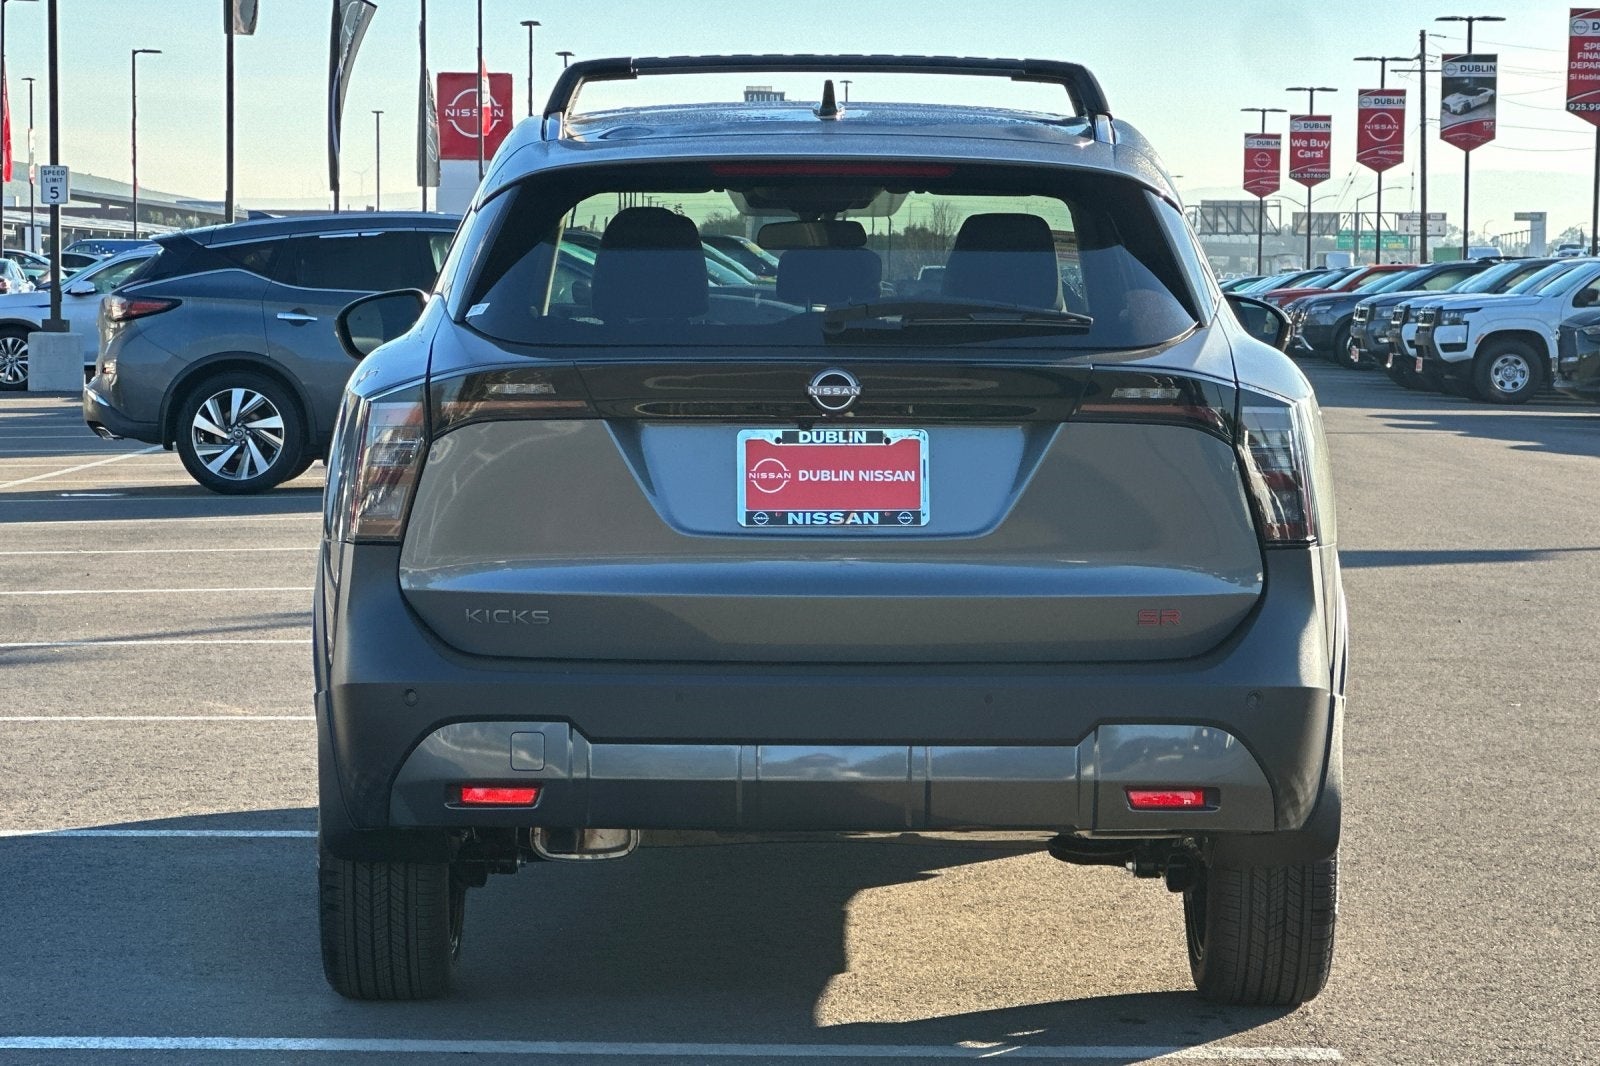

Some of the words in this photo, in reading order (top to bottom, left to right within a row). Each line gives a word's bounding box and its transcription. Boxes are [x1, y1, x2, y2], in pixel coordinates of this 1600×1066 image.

[1460, 64, 1496, 73] DUBLIN
[445, 108, 504, 118] NISSN
[1291, 139, 1308, 147] We
[1310, 139, 1330, 149] Buy
[1297, 149, 1324, 158] Cars!
[50, 186, 60, 200] 5
[808, 386, 861, 396] NISSAN
[798, 431, 867, 444] DUBLIN
[798, 470, 854, 482] DUBLIN
[858, 470, 916, 482] NISSAN
[787, 512, 879, 525] NISSAN
[465, 608, 550, 625] KICKS
[1137, 608, 1181, 626] SR
